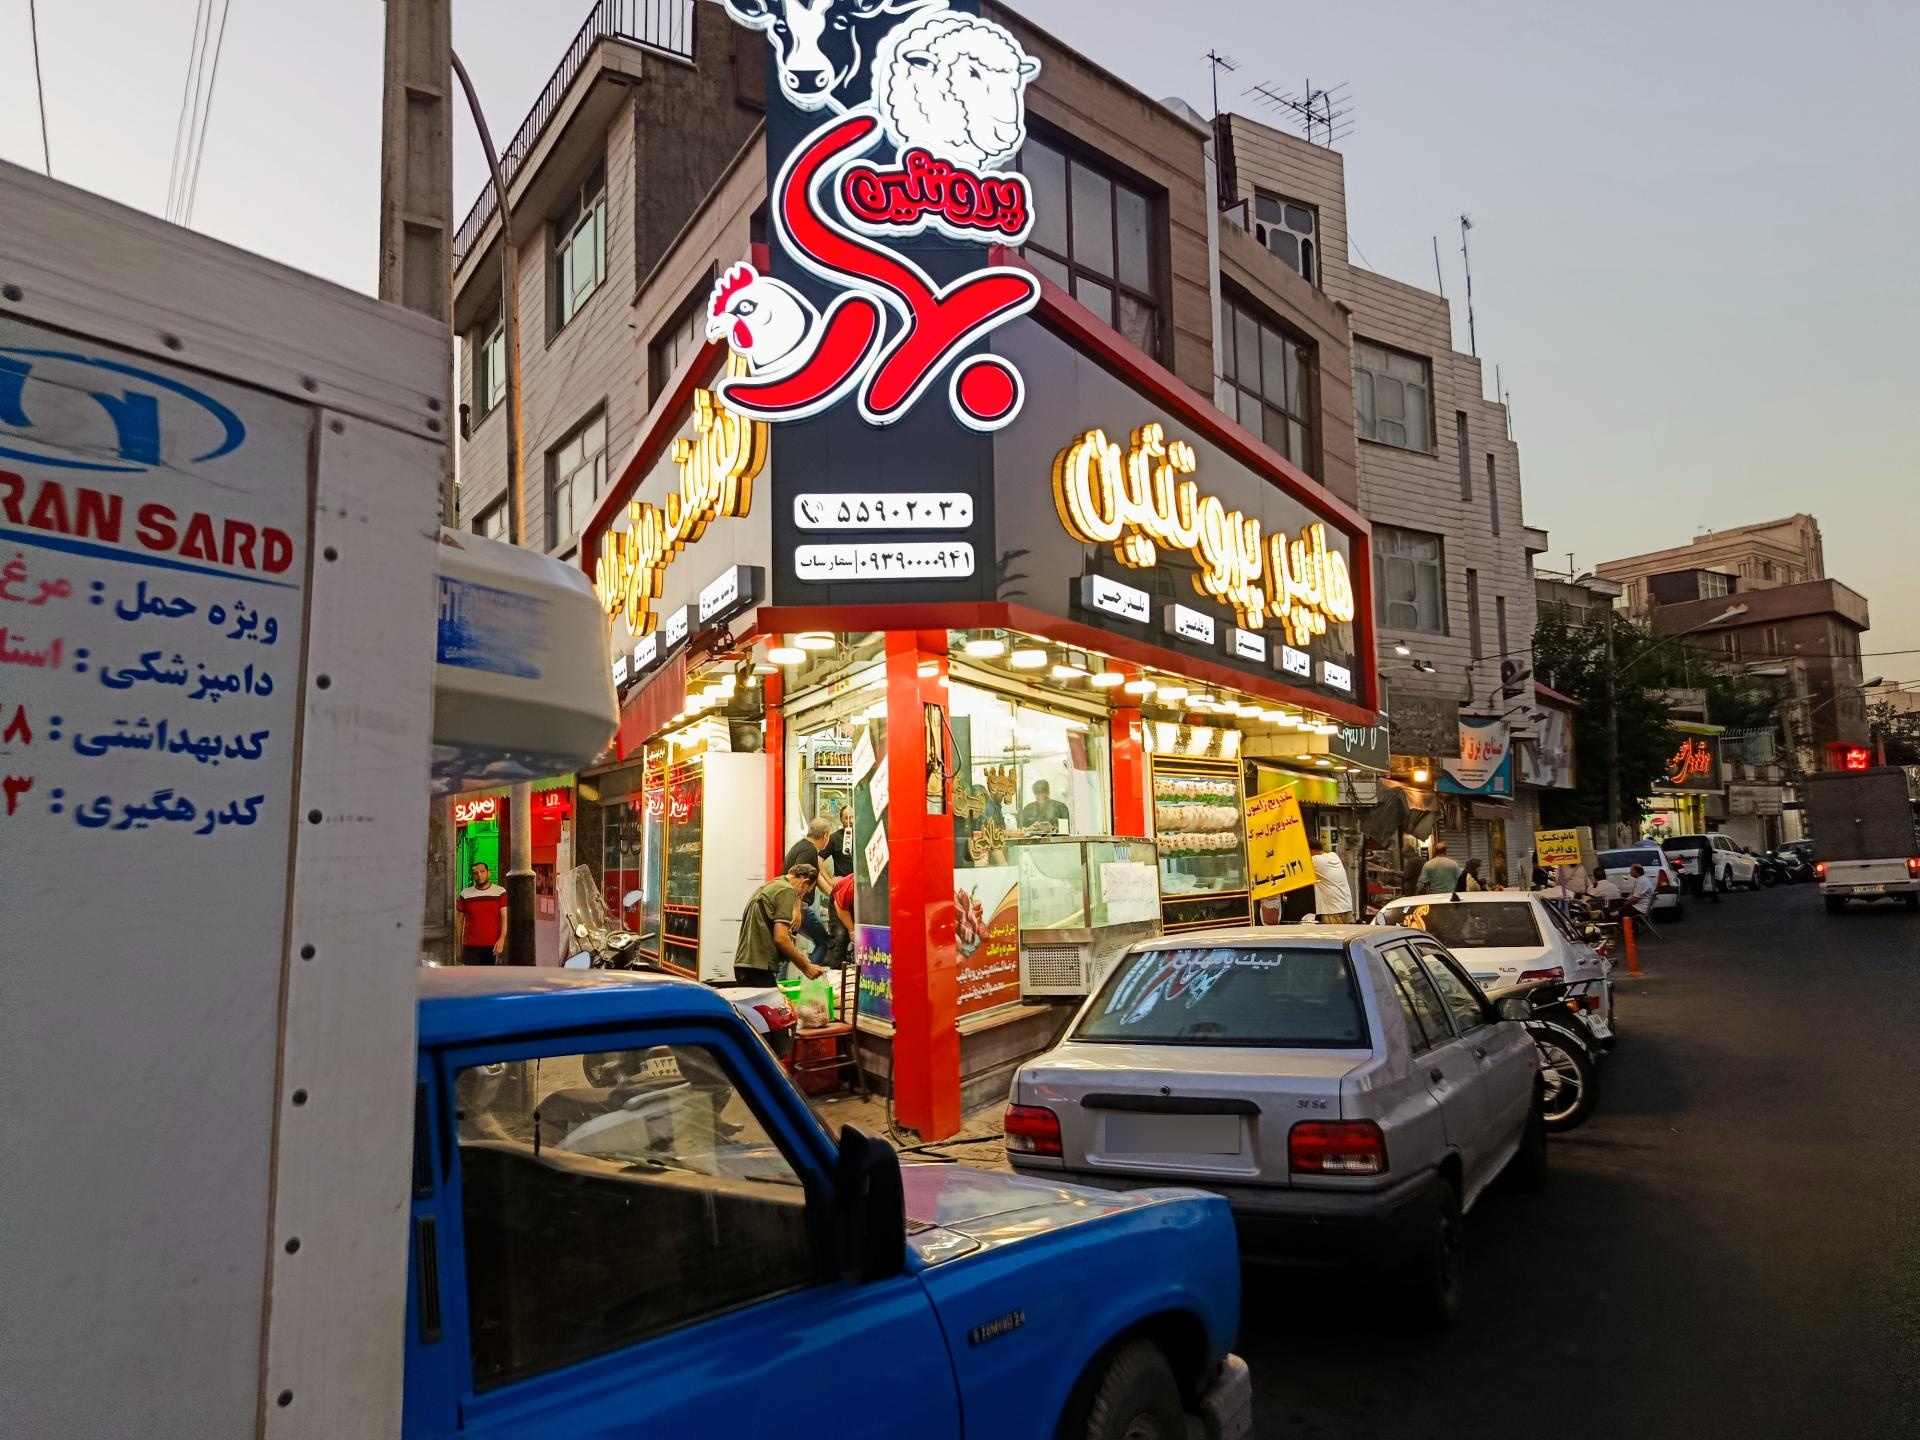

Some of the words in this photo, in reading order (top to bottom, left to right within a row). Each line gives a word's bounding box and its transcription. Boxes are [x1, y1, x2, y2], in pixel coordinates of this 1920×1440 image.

[838, 142, 1034, 240] پروتئین
[136, 503, 293, 574] SARD
[837, 500, 968, 523] ۵۵۹۰۲۰۳۰
[1052, 422, 1266, 630] پروتئین
[1262, 522, 1355, 647] هایپر
[209, 600, 278, 645] ویژه
[100, 651, 274, 704] دامپزشکی
[967, 816, 1007, 861] ماهی
